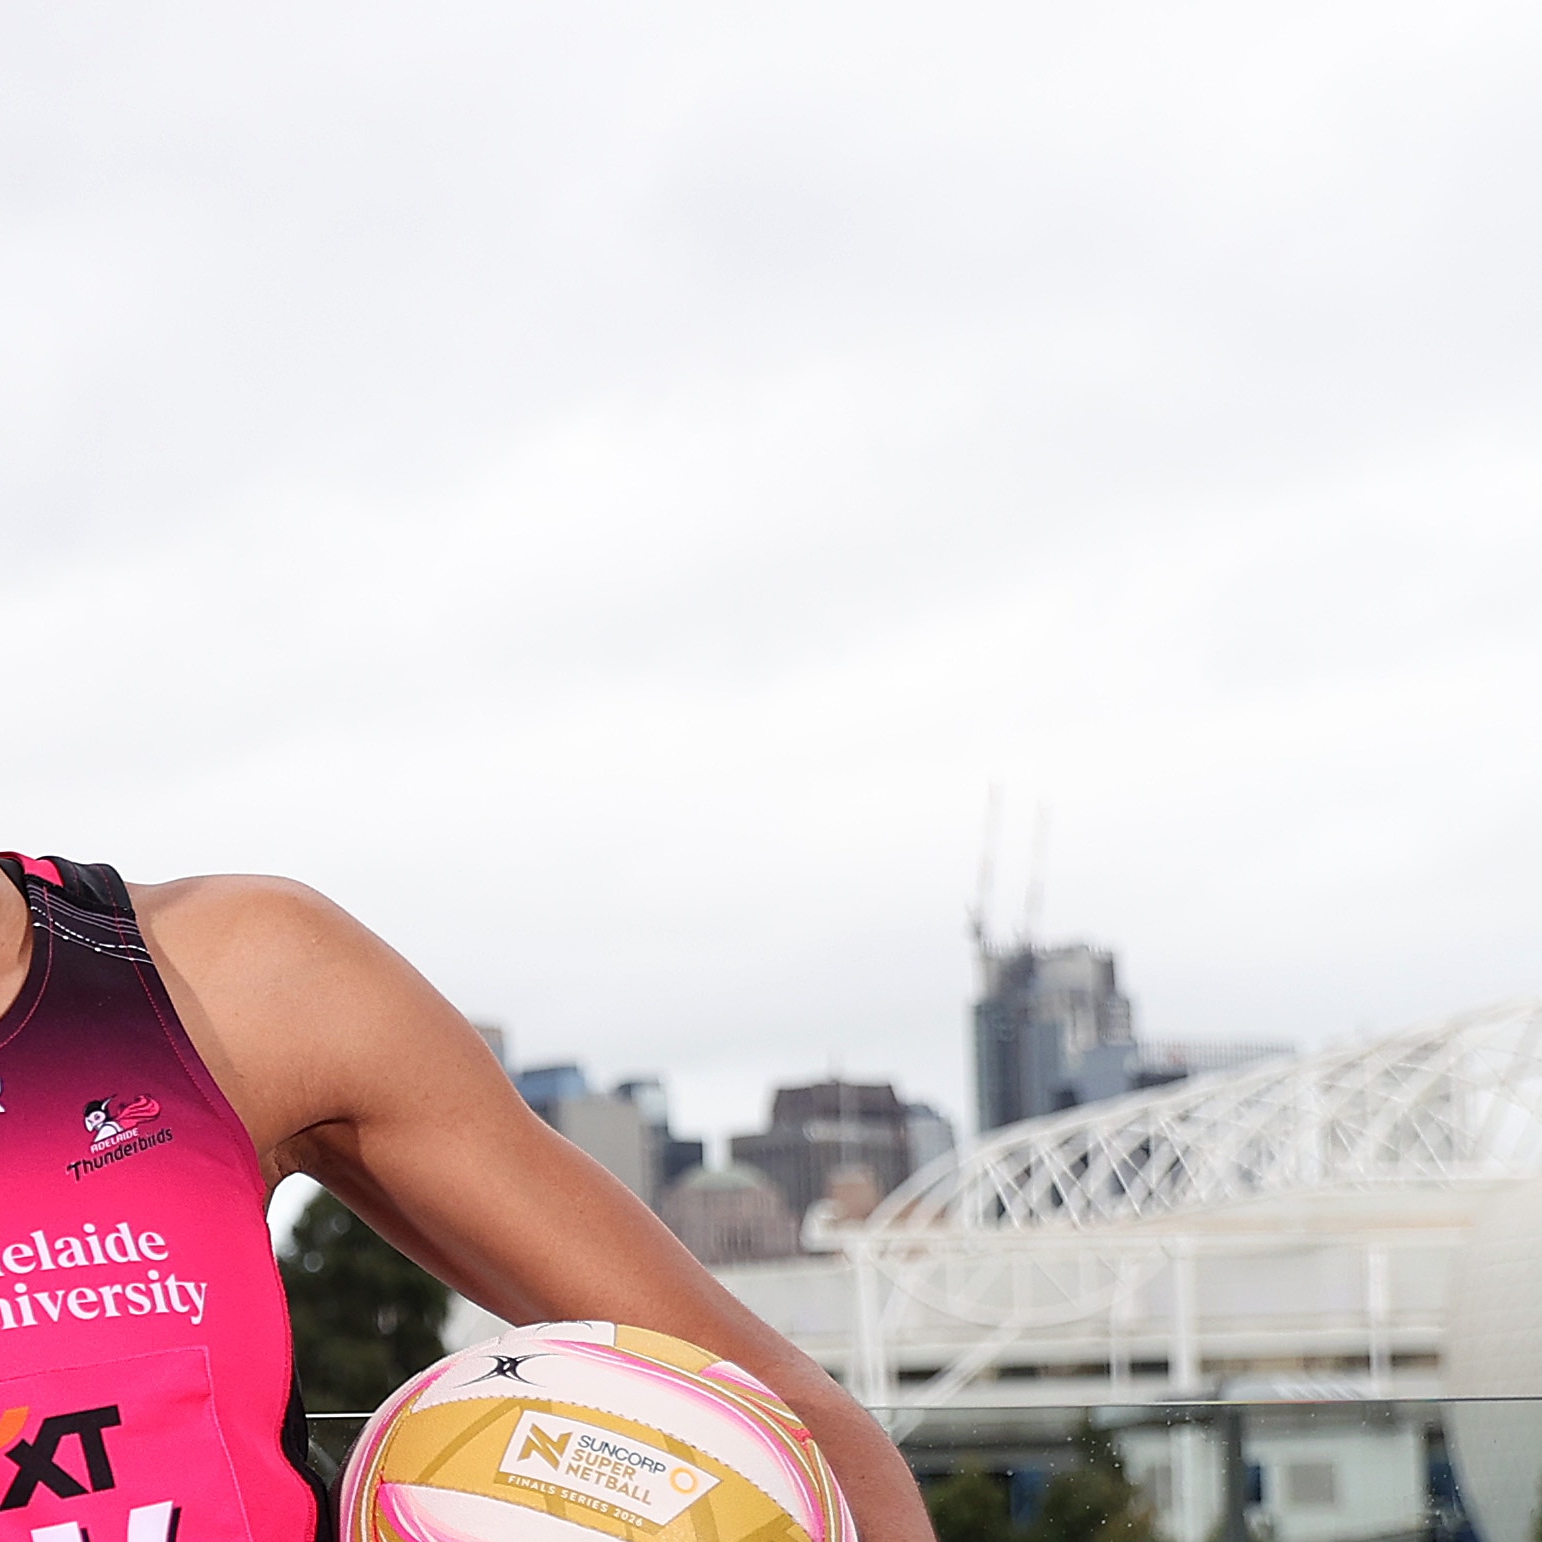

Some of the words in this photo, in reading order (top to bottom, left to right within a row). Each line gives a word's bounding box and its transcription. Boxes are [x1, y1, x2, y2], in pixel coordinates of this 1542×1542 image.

[66, 1127, 173, 1183] Thunderbirds
[90, 1128, 139, 1154] ADELAIDE
[571, 1449, 638, 1482] SUPER
[577, 1435, 667, 1474] SUNCORP
[507, 1475, 556, 1495] FINALS
[560, 1489, 609, 1513] SERIES
[613, 1508, 644, 1527] 2026
[565, 1463, 652, 1506] NETBALL
